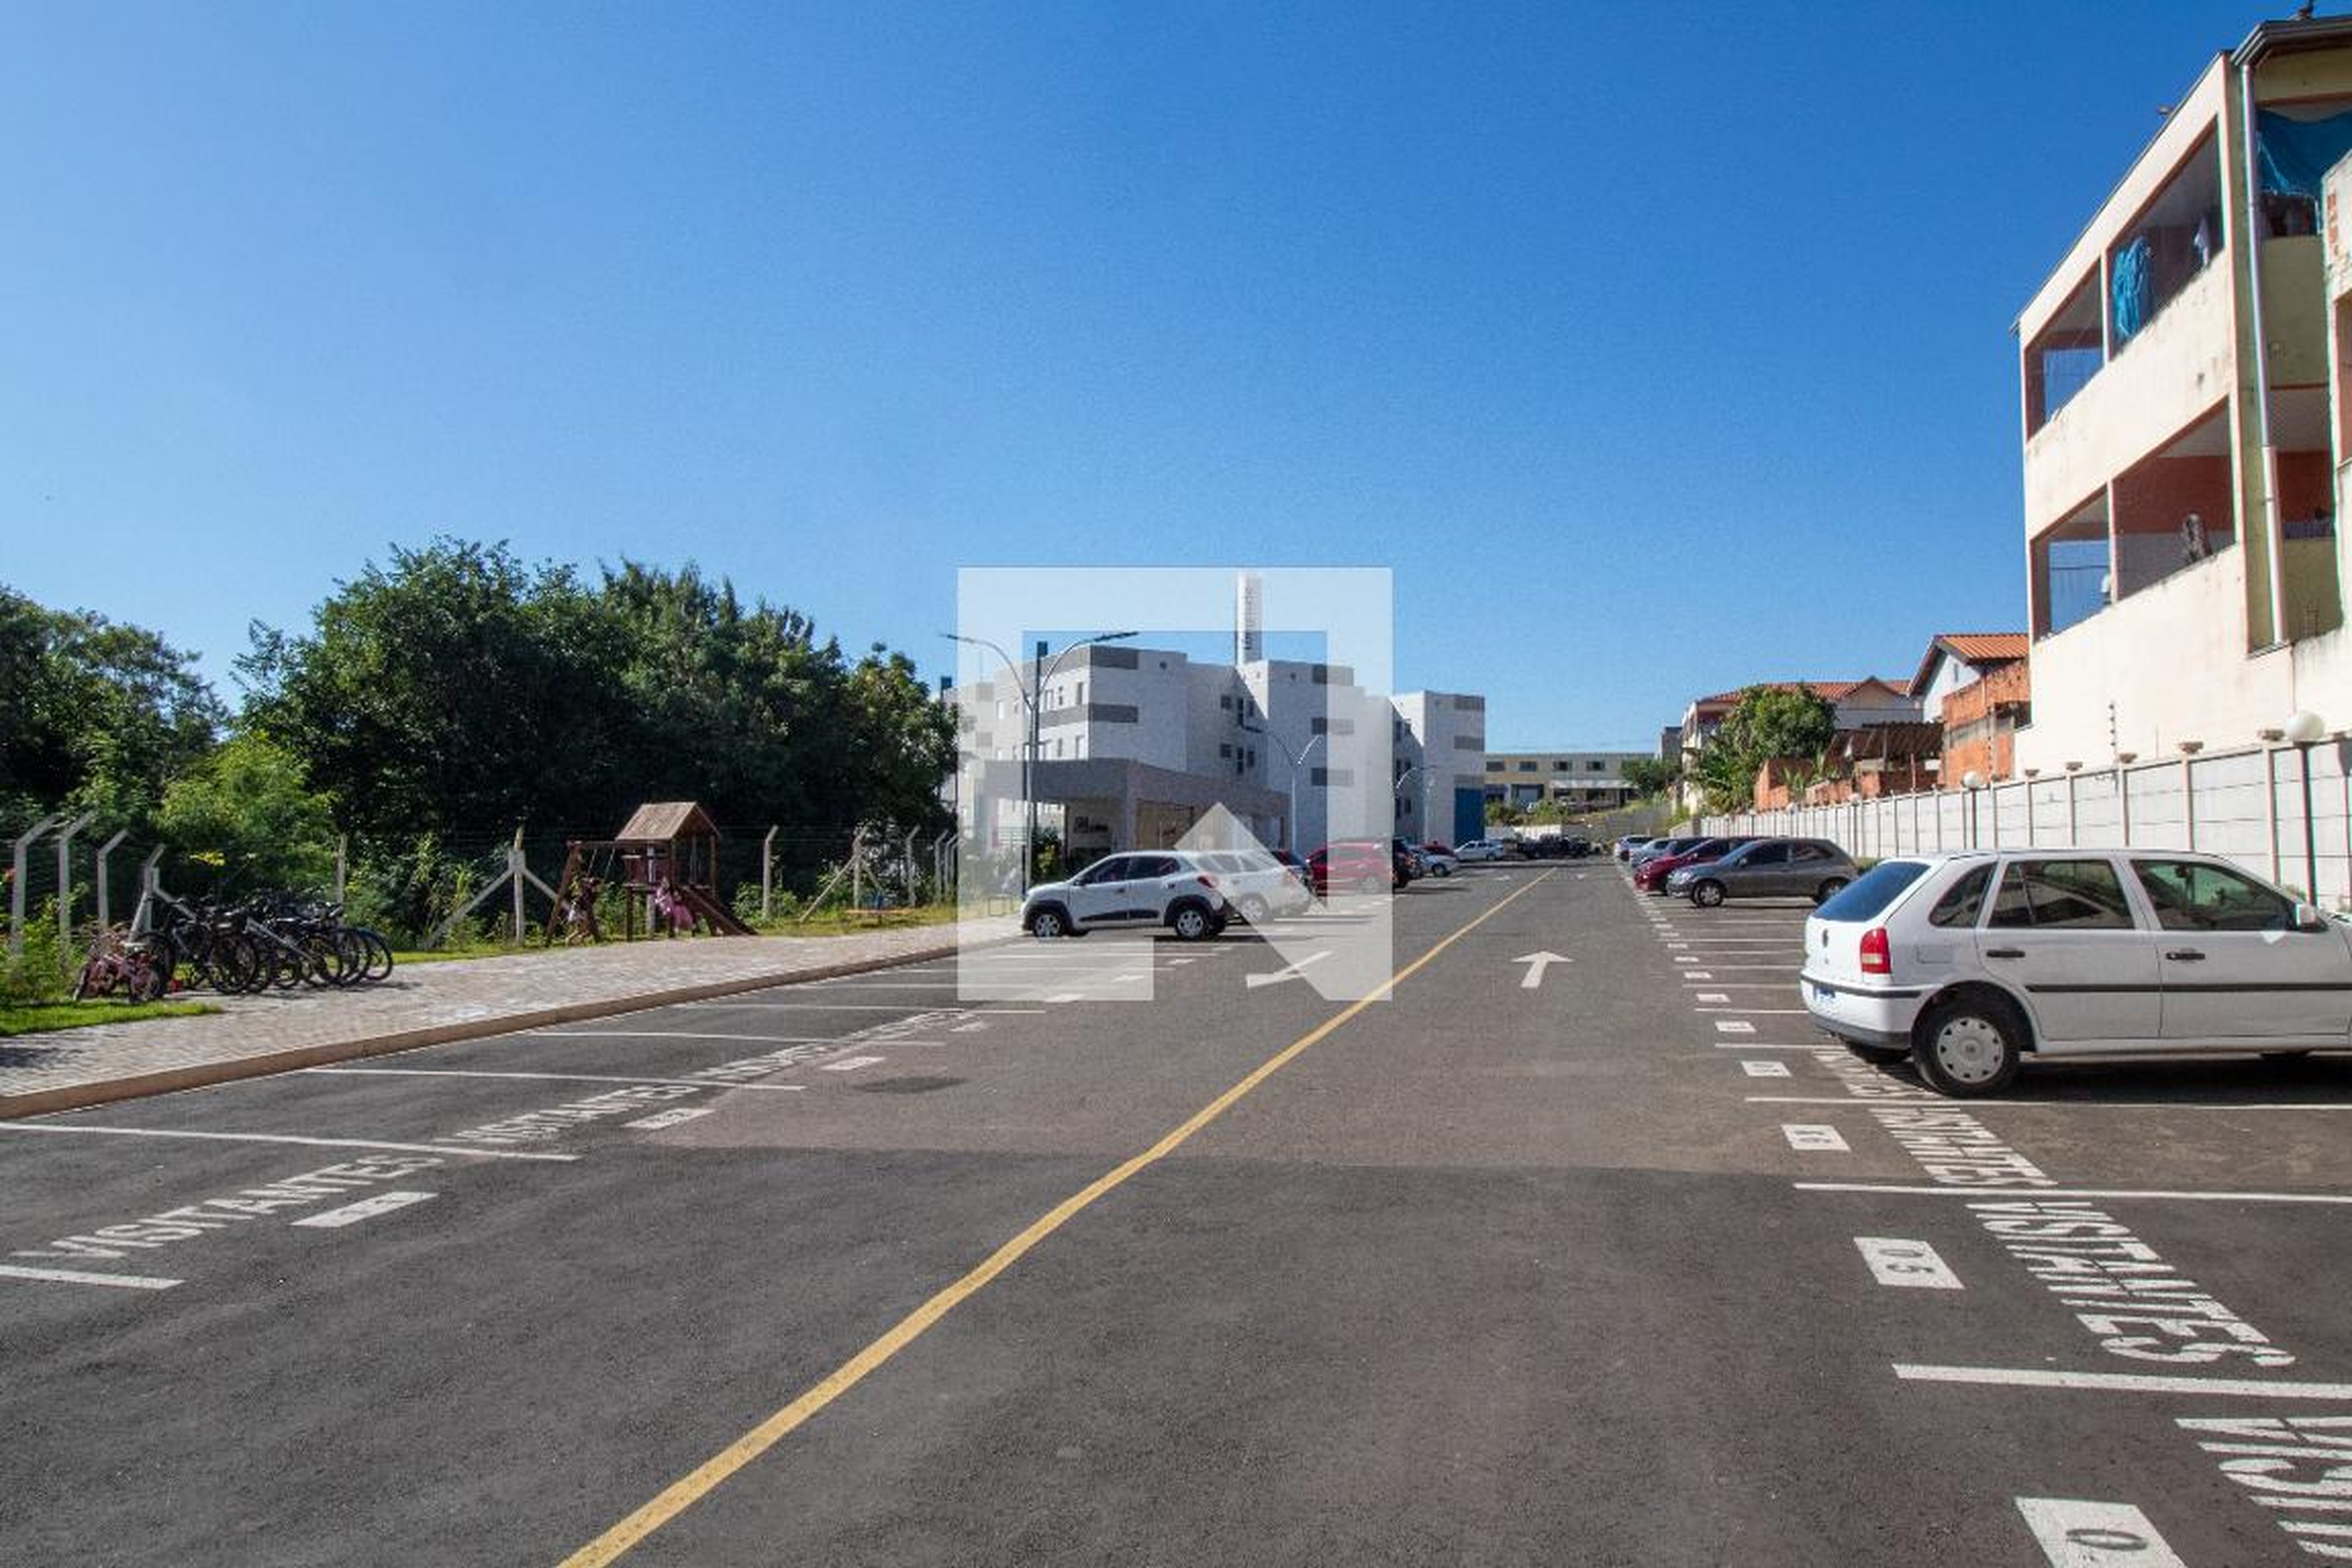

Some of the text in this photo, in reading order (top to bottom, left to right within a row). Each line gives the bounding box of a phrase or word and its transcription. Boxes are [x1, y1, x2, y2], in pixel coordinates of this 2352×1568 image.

[9, 1155, 445, 1257] VISITANTES
[1878, 1248, 1935, 1273] 05
[1966, 1201, 2296, 1366] VISITANTES
